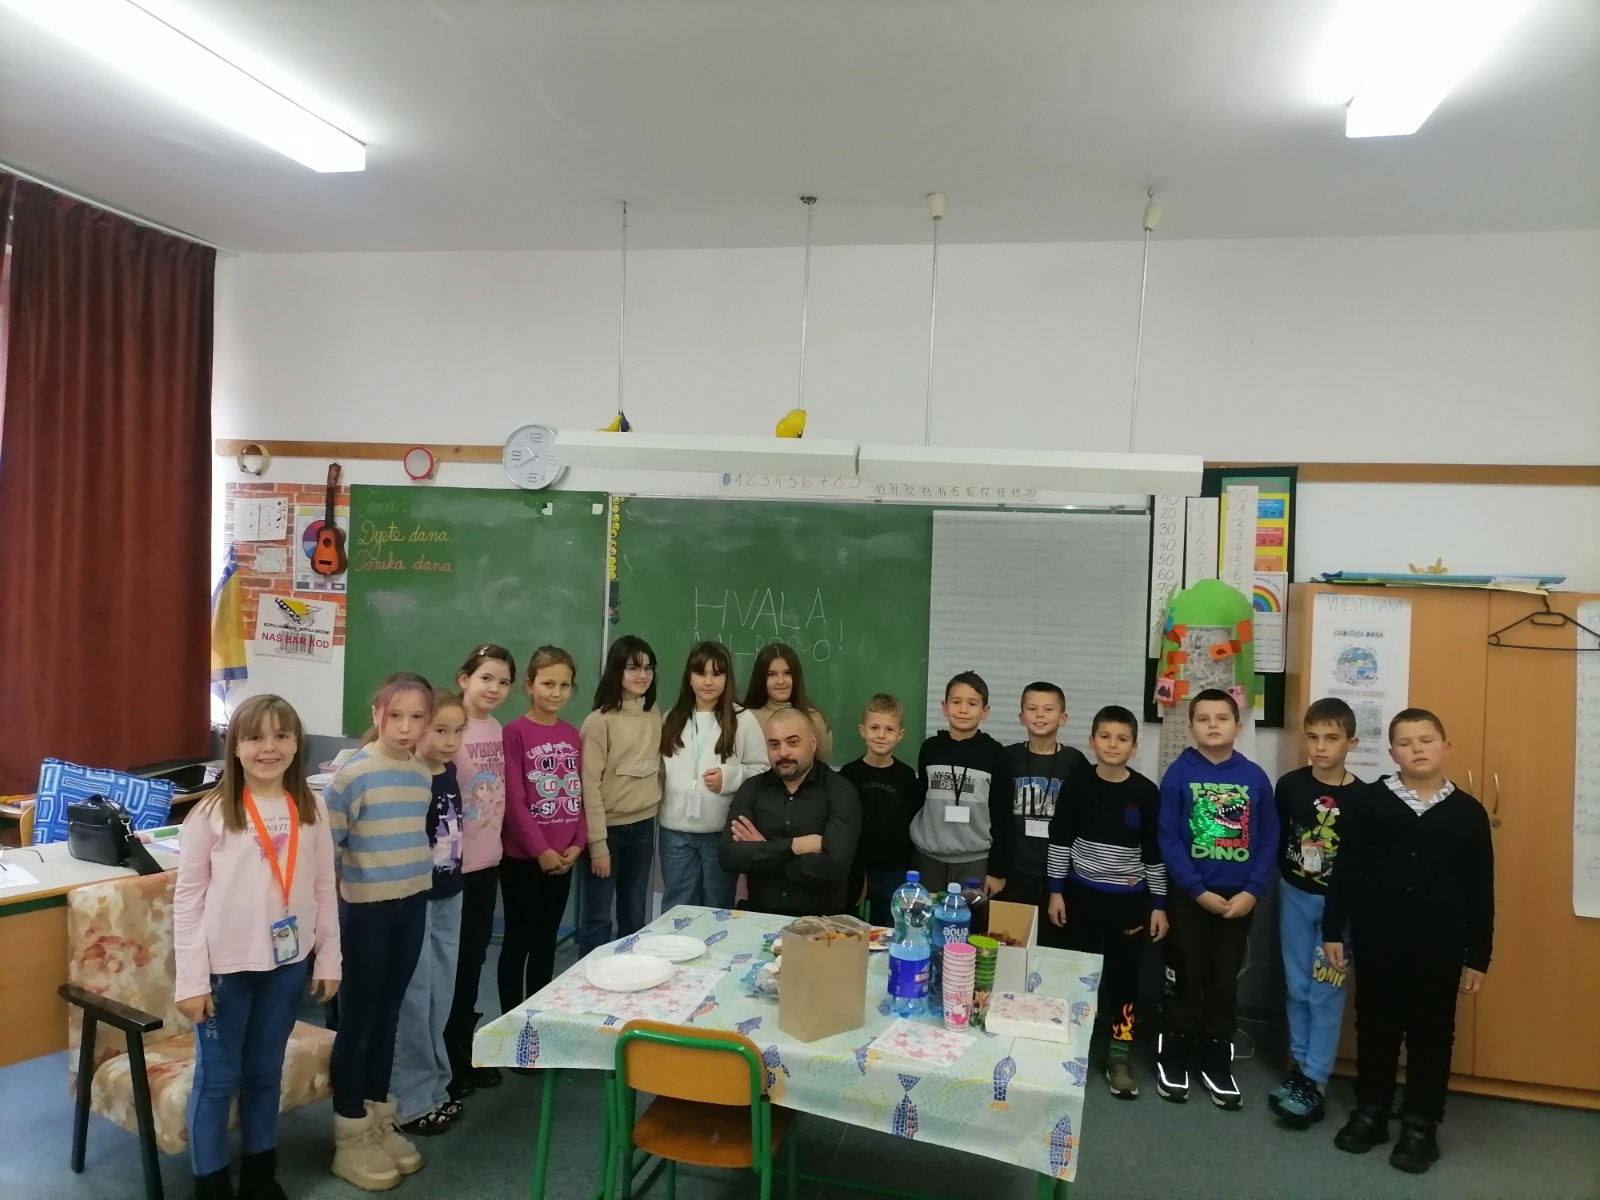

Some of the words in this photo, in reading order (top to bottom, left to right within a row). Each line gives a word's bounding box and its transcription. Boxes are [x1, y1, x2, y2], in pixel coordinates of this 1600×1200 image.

[1160, 507, 1177, 520] 20
[1159, 522, 1177, 536] 30
[1159, 539, 1176, 552] 40
[1157, 554, 1176, 567] 50
[1157, 569, 1175, 581] 60
[694, 586, 828, 635] HVALA
[284, 634, 307, 646] BAR
[309, 637, 330, 649] KOD
[1189, 782, 1250, 801] T-REX
[1190, 843, 1250, 862] DINO
[1311, 958, 1347, 988] SONIC
